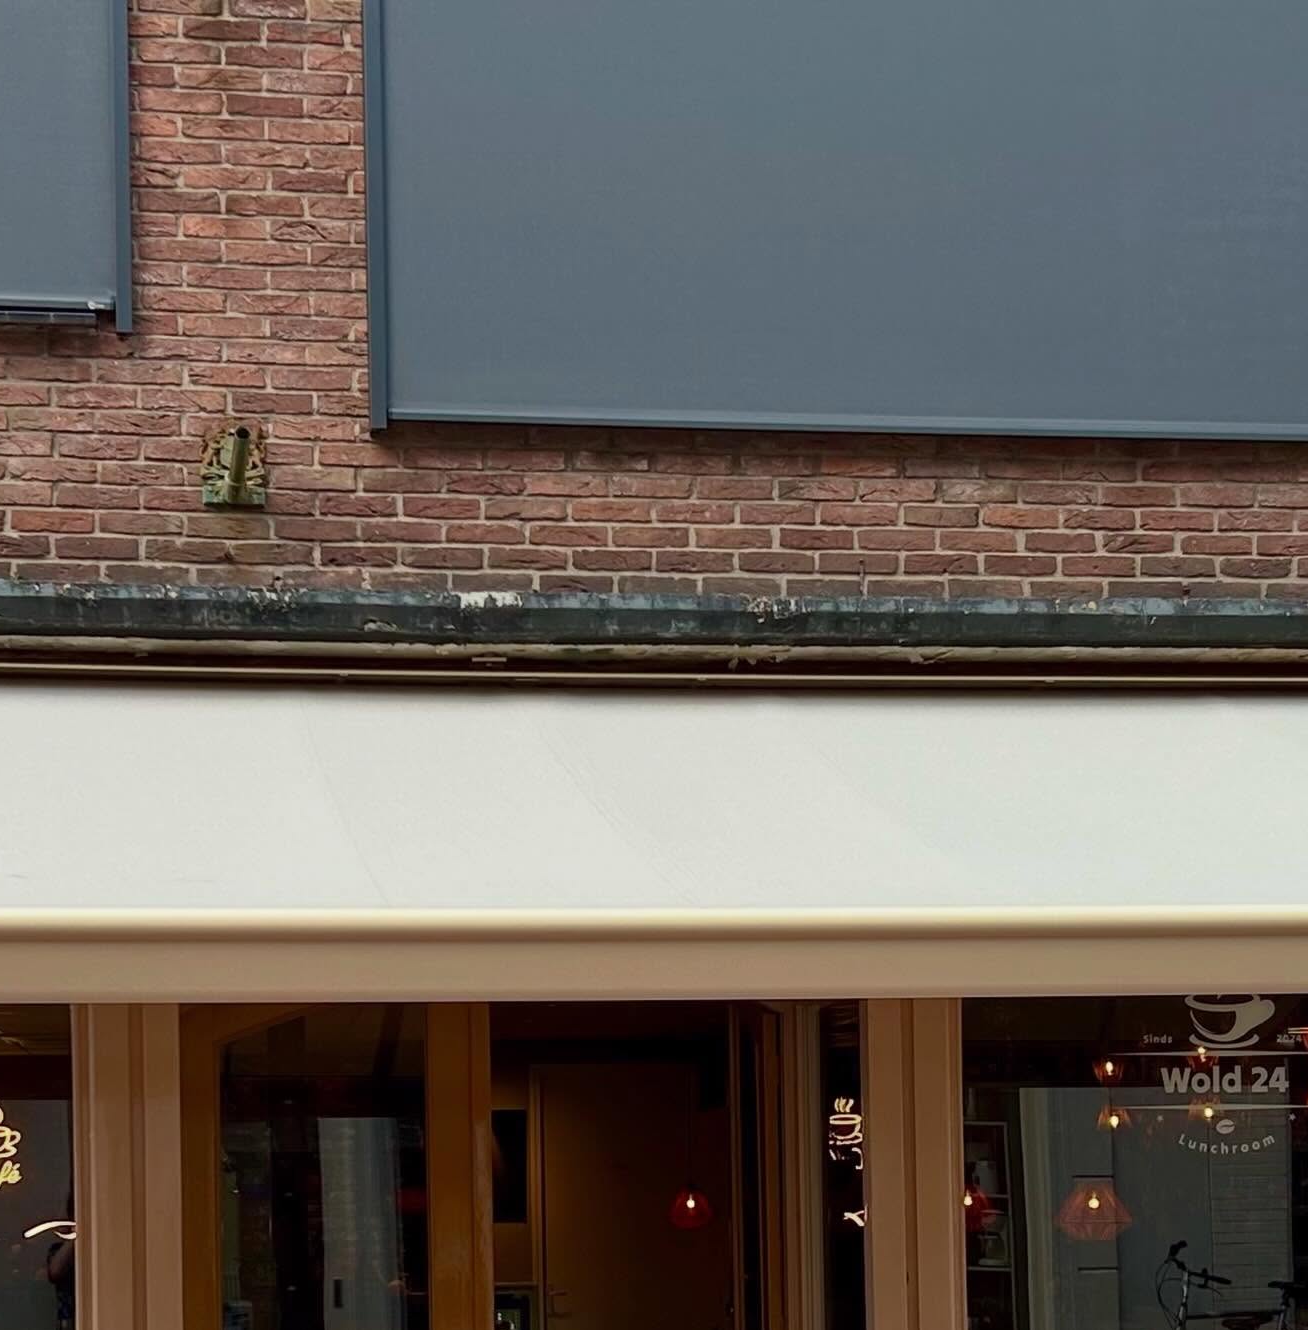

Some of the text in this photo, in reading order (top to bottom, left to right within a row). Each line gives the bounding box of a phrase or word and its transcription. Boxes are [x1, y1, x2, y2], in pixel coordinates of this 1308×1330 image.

[1143, 1034, 1173, 1044] Sinds
[1160, 1065, 1290, 1094] Wold 24
[1178, 1134, 1276, 1155] Lunchroom
